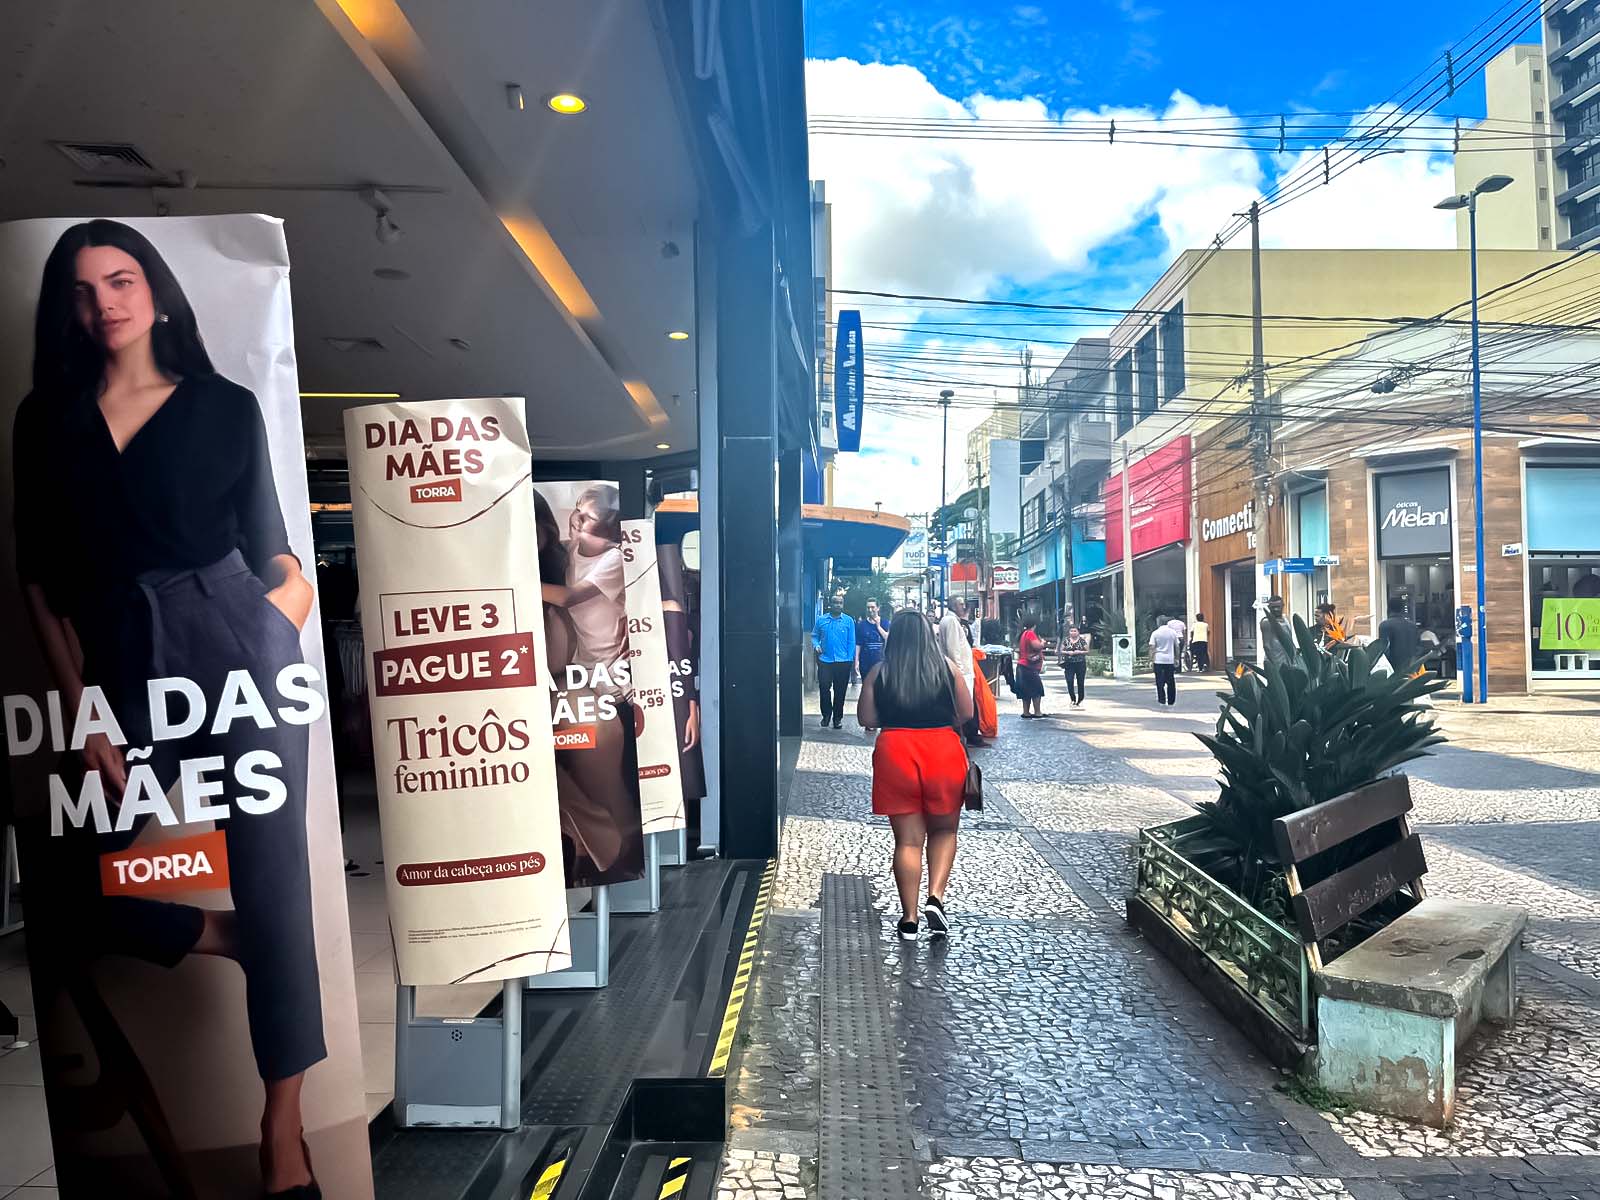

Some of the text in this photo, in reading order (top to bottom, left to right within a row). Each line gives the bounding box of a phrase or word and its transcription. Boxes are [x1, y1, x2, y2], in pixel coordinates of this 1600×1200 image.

[365, 416, 501, 450] DIA DAS
[385, 443, 484, 481] MÃES
[416, 486, 456, 499] TORRA
[1202, 501, 1253, 542] Connecti
[1380, 506, 1449, 530] Melani
[621, 529, 642, 545] AS
[393, 603, 500, 637] LEVE 3
[628, 616, 653, 634] as
[382, 650, 492, 687] PAGUE
[565, 659, 631, 690] DAS
[667, 658, 693, 677] AS
[4, 663, 325, 757] DIA DAS
[552, 690, 618, 725] ÃES
[387, 708, 530, 762] Tricôs
[49, 746, 288, 837] MÃES
[393, 758, 530, 794] feminino
[113, 851, 214, 885] TORRA
[400, 855, 541, 880] Amor da cabeça aos pés
